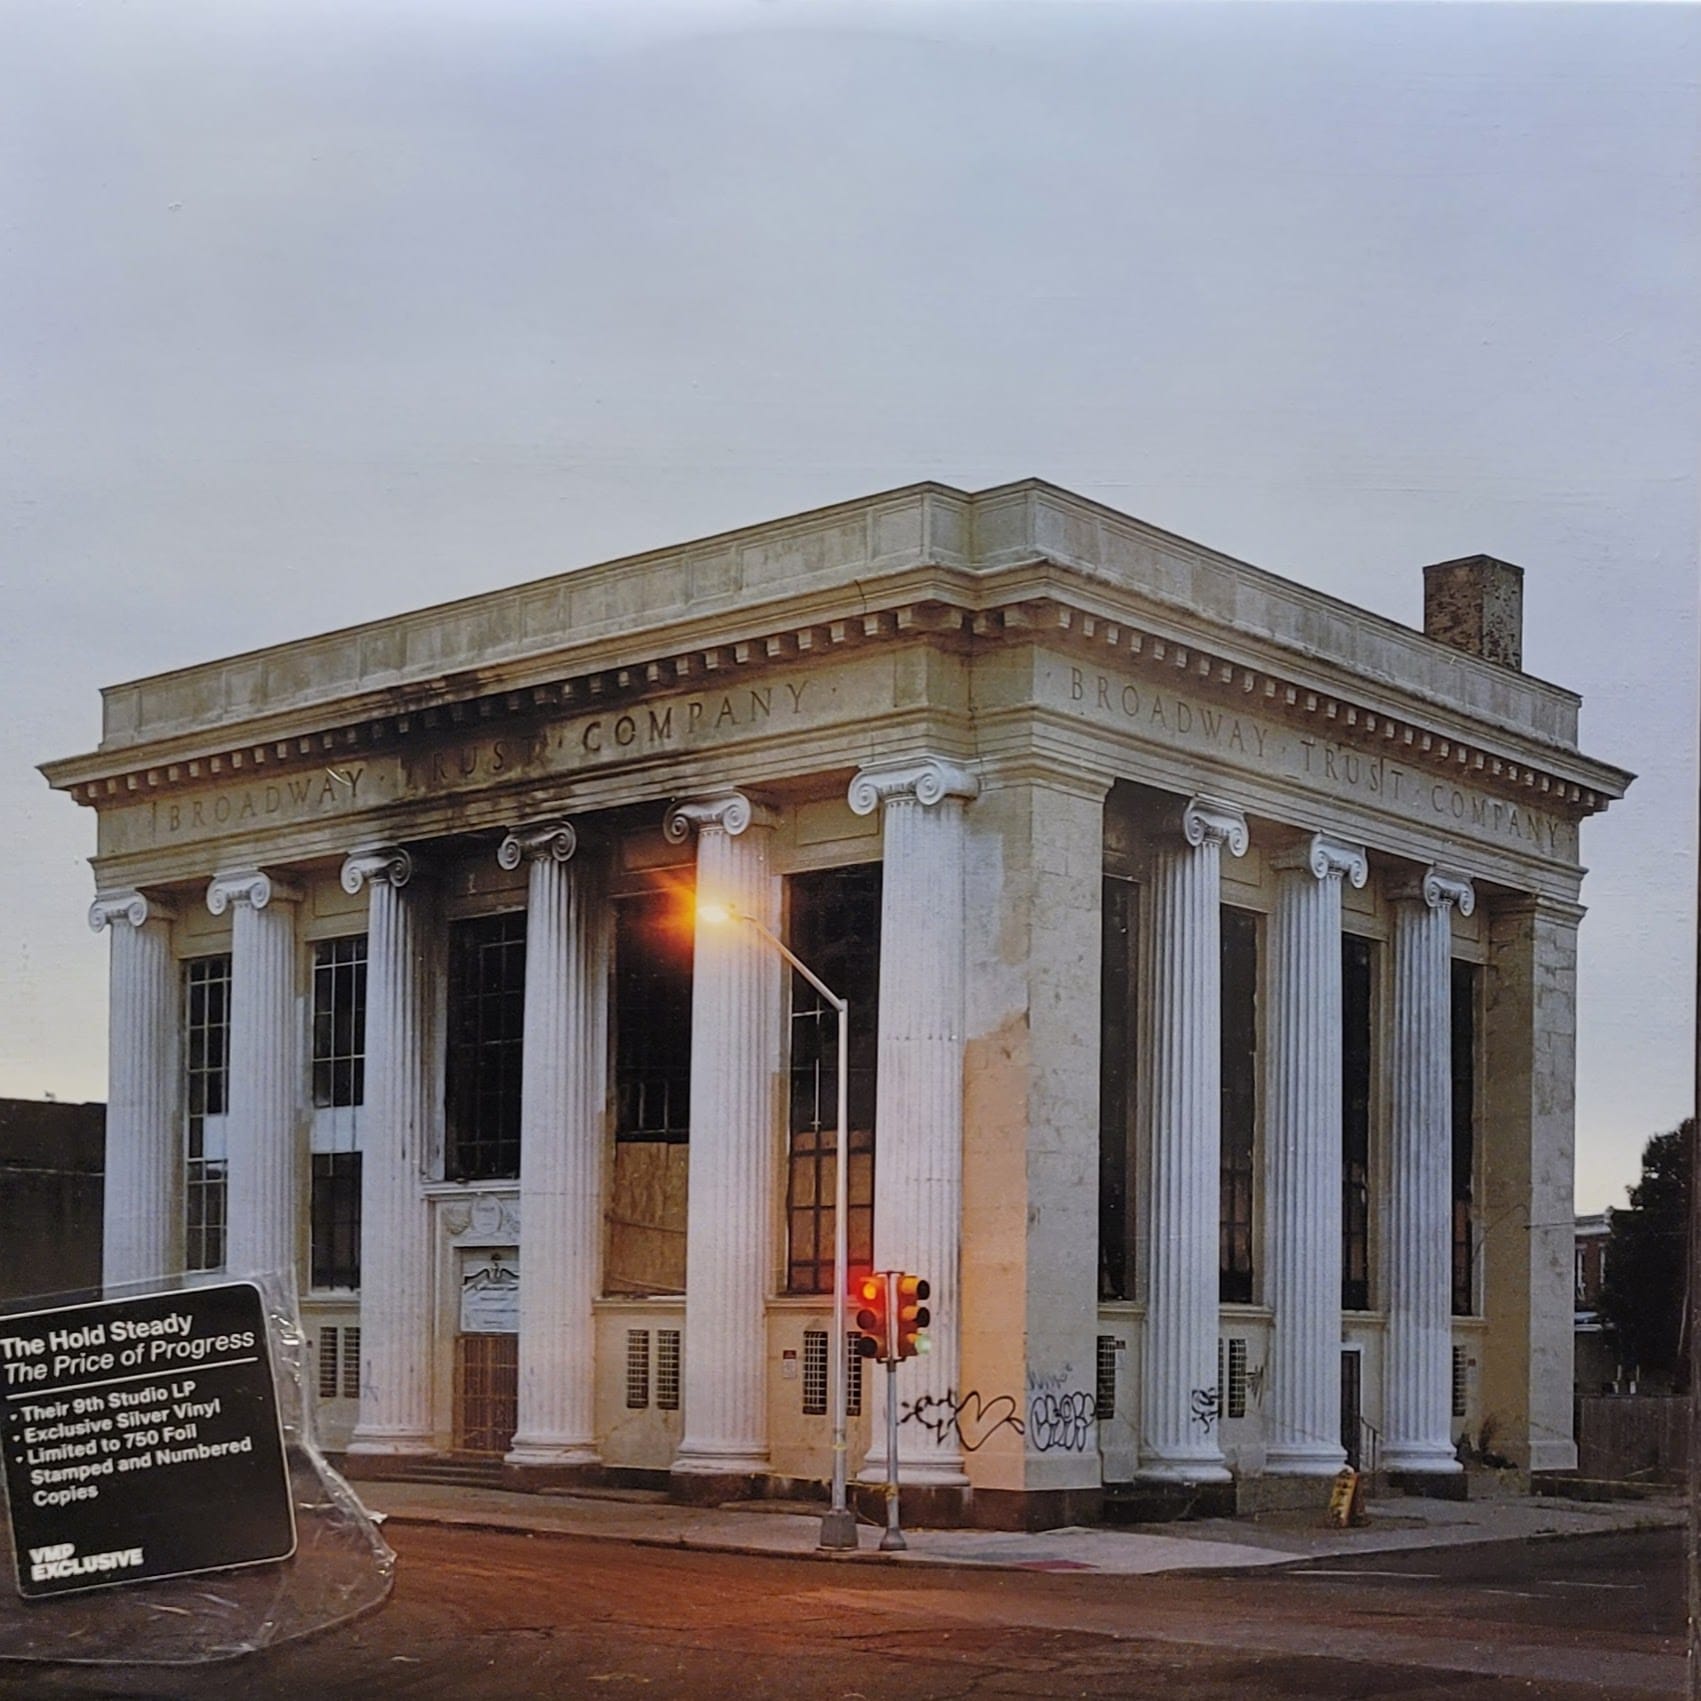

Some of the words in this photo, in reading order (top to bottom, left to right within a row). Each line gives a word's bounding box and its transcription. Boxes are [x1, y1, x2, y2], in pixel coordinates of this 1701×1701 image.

[168, 768, 364, 832] BROADWAY
[582, 679, 809, 753] COMPANY
[1071, 667, 1268, 758] BROADWAY
[1301, 740, 1403, 800] TRUST
[1431, 785, 1560, 849] COMPANY
[1, 1337, 46, 1360] The
[49, 1324, 106, 1352] Hold
[110, 1313, 193, 1342] Steady
[4, 1362, 48, 1385] The
[53, 1352, 114, 1378] Price
[120, 1343, 146, 1366] of
[150, 1331, 255, 1359] Progress
[20, 1401, 69, 1422] Their
[72, 1397, 105, 1413] 9th
[107, 1387, 168, 1409] Studio
[171, 1380, 197, 1399] LP
[24, 1418, 113, 1444] Exclusive
[116, 1407, 170, 1429] Silver
[172, 1397, 221, 1420] Vinyl
[27, 1439, 98, 1465] Limited
[101, 1436, 121, 1453] to
[124, 1430, 159, 1449] 750
[162, 1423, 198, 1443] Foil
[30, 1459, 114, 1486] Stamped
[117, 1452, 152, 1472] and
[155, 1436, 253, 1466] Numbered
[32, 1484, 99, 1507] Copies
[28, 1543, 75, 1564] VMP
[31, 1547, 144, 1581] EXCLUSIVE
